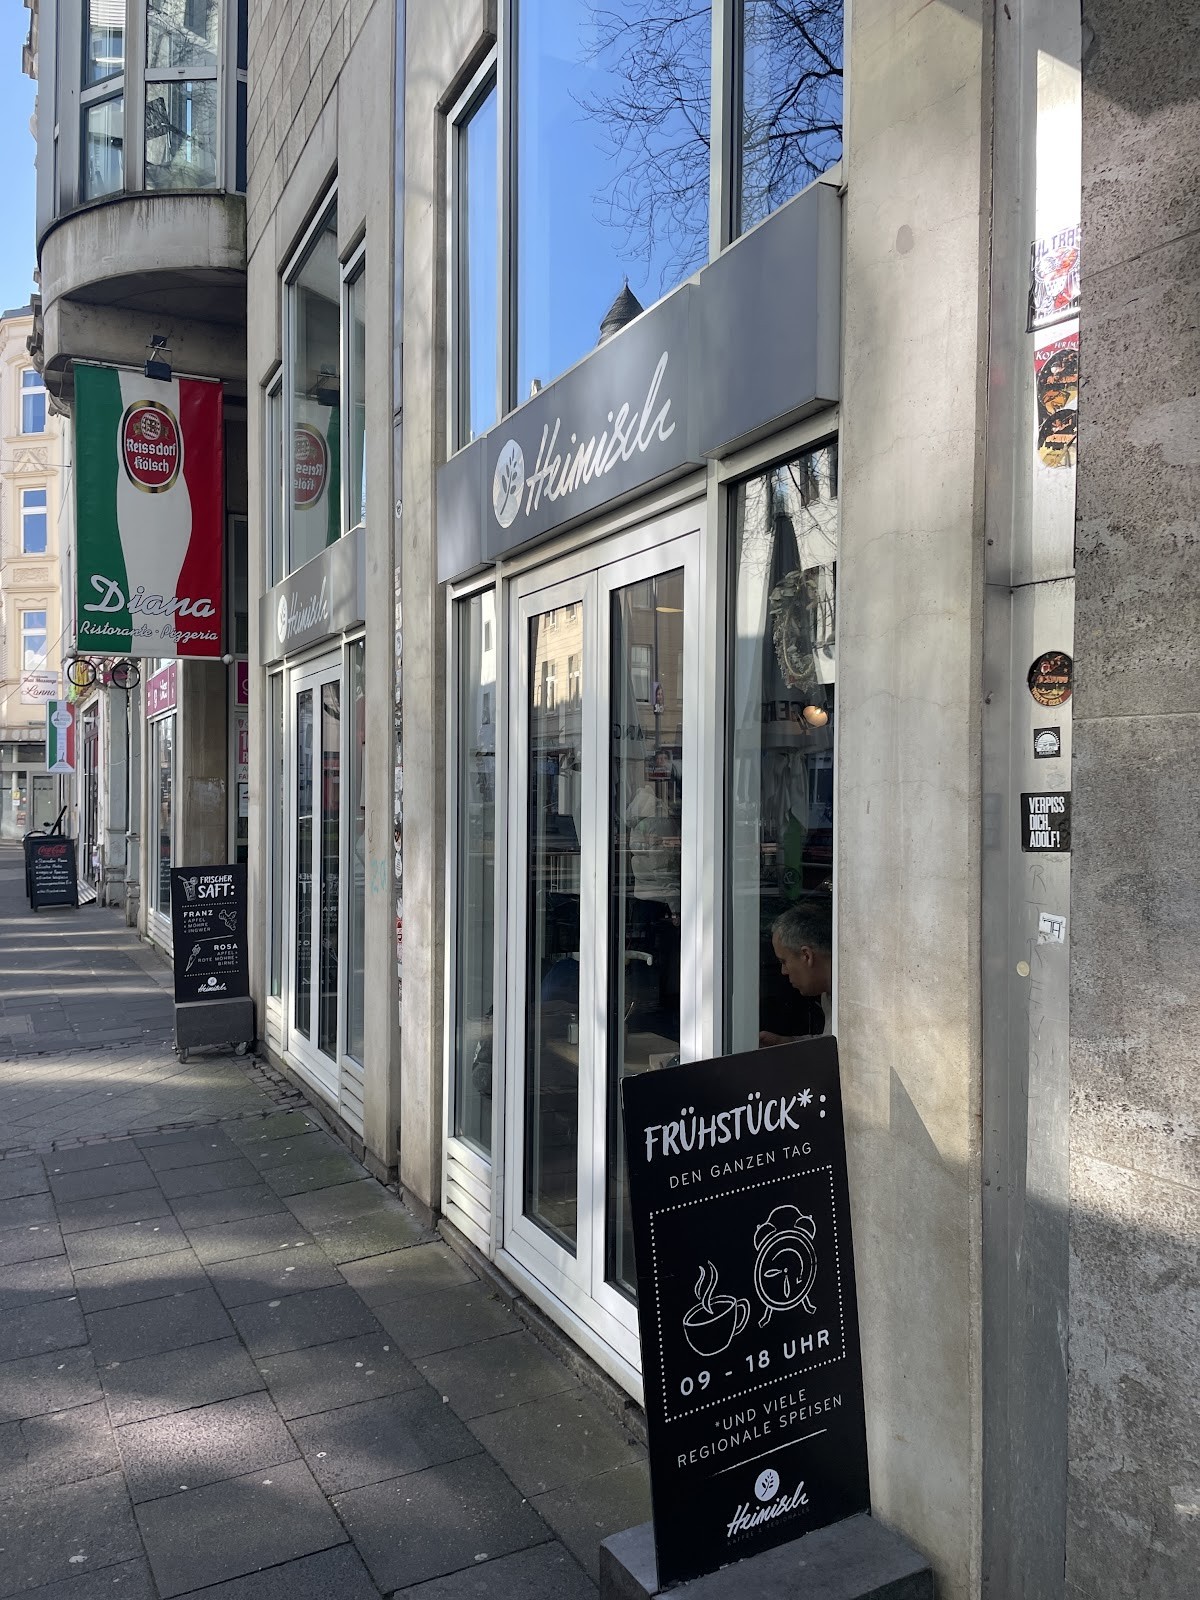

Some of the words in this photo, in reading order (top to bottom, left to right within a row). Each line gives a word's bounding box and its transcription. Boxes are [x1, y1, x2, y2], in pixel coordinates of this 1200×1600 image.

[525, 351, 676, 516] Heimisch
[126, 438, 177, 457] Reissdorf
[133, 456, 170, 474] Kölsch
[83, 574, 216, 618] Diana
[287, 576, 329, 639] Heimisch
[79, 620, 153, 638] Ristorante
[160, 623, 219, 644] Pizzeria
[21, 684, 56, 699] Lanna
[1028, 796, 1065, 813] VERPISS
[1029, 831, 1060, 848] ADOLF!
[199, 874, 233, 884] FRISCHER
[197, 883, 235, 899] SAFT:
[183, 910, 214, 918] FRANZ
[213, 943, 238, 951] ROSA
[669, 1169, 702, 1189] DEN
[710, 1150, 776, 1178] GANZEN
[782, 1142, 812, 1160] TAG
[680, 1370, 711, 1396] 09
[745, 1349, 770, 1373] 18
[783, 1329, 830, 1360] UHR
[763, 1388, 807, 1414] VIELE
[677, 1421, 772, 1469] REGIONALE
[779, 1394, 842, 1429] SPEISEN
[726, 1481, 809, 1538] Heimisch
